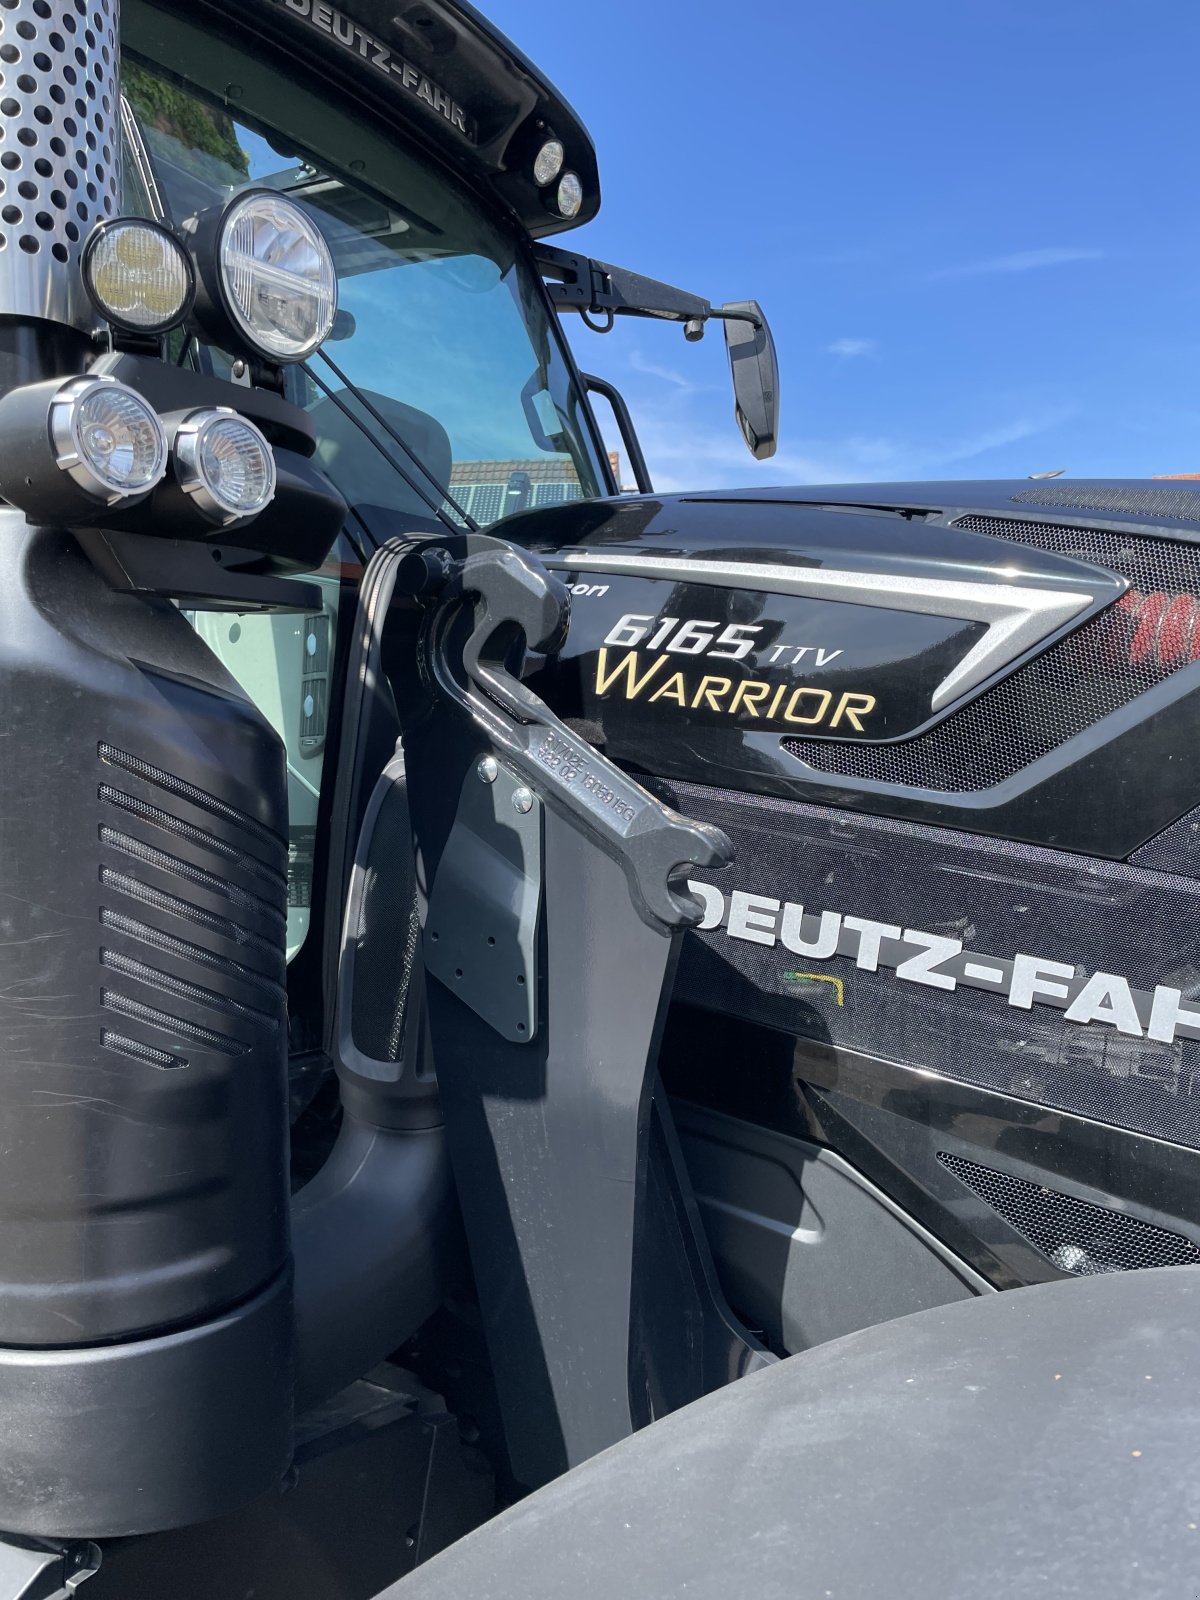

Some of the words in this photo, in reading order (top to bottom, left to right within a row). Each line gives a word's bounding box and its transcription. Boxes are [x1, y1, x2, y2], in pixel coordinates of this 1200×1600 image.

[285, 0, 466, 132] DEUTZ-FAHR
[604, 613, 764, 660] 6165
[769, 645, 844, 667] TTV
[594, 647, 876, 732] WARRIOR
